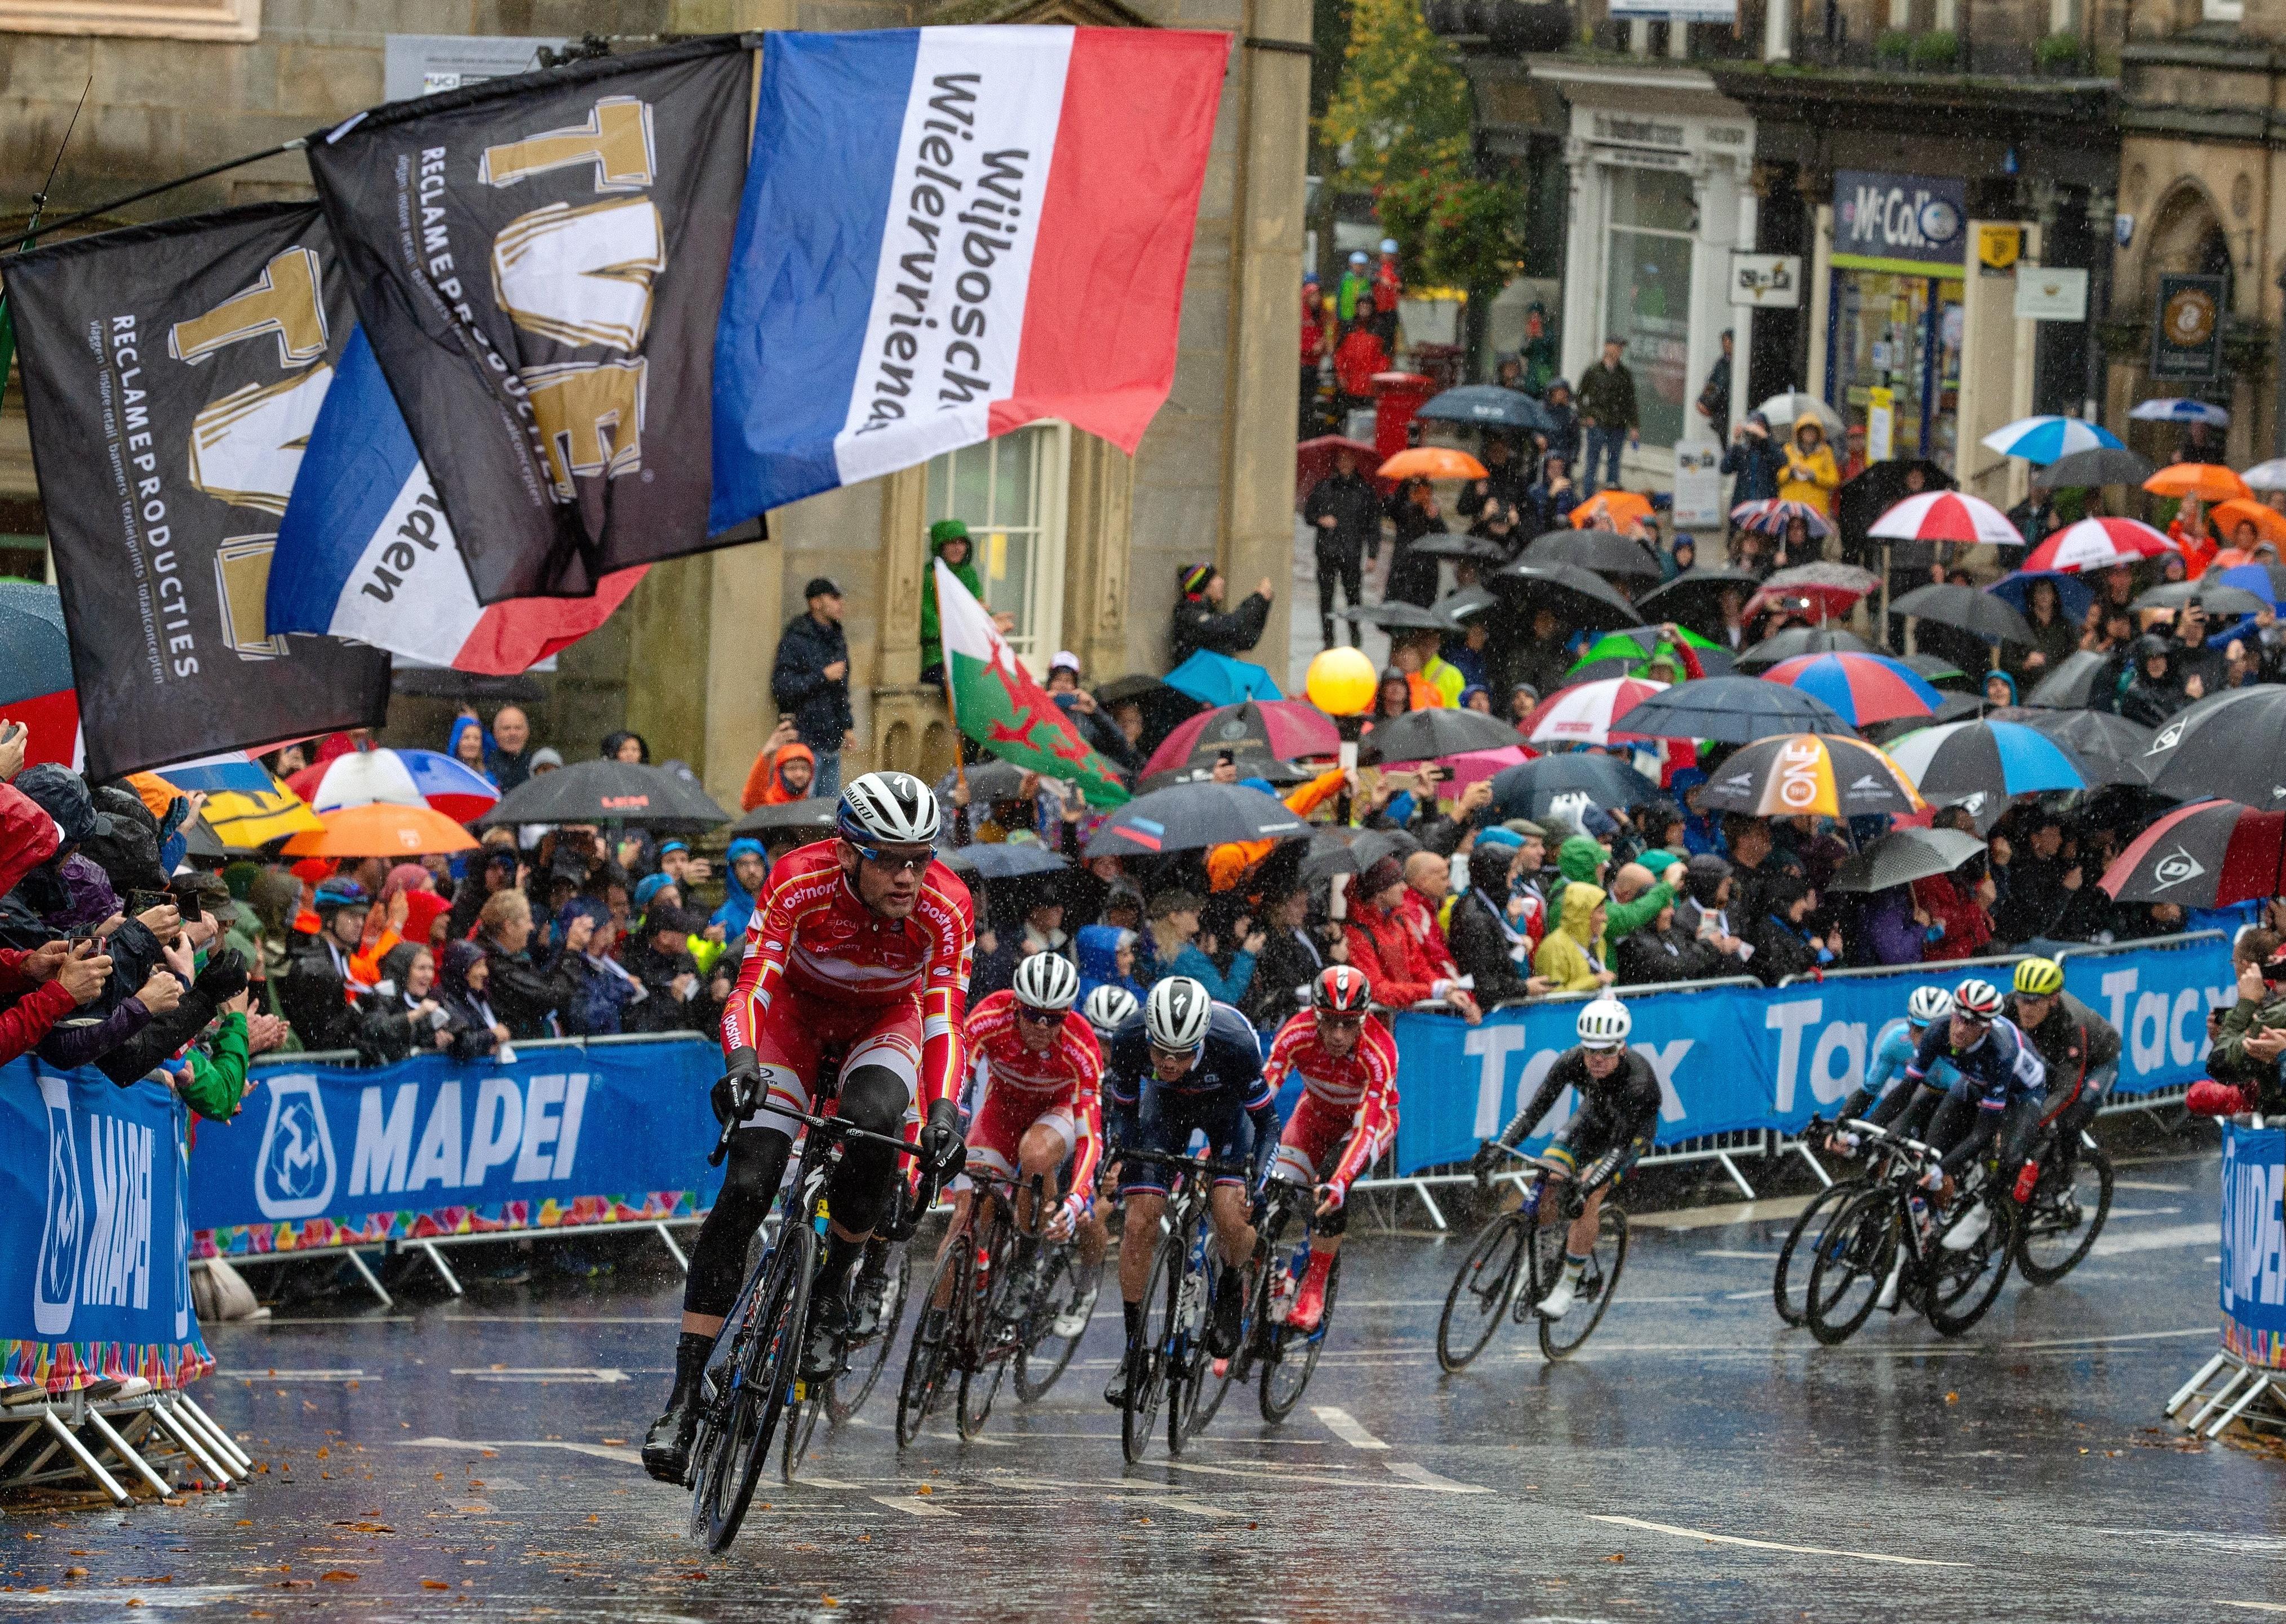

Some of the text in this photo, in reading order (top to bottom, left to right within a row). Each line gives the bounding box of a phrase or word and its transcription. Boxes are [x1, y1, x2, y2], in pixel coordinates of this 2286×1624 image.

[108, 445, 128, 497] banners
[112, 314, 199, 677] RECLAMEPRODUCTIES
[1781, 744, 1821, 807] ONE
[348, 1073, 591, 1197] MAPEI
[1464, 1025, 1695, 1139] Tax
[83, 1113, 153, 1310] MAPEI
